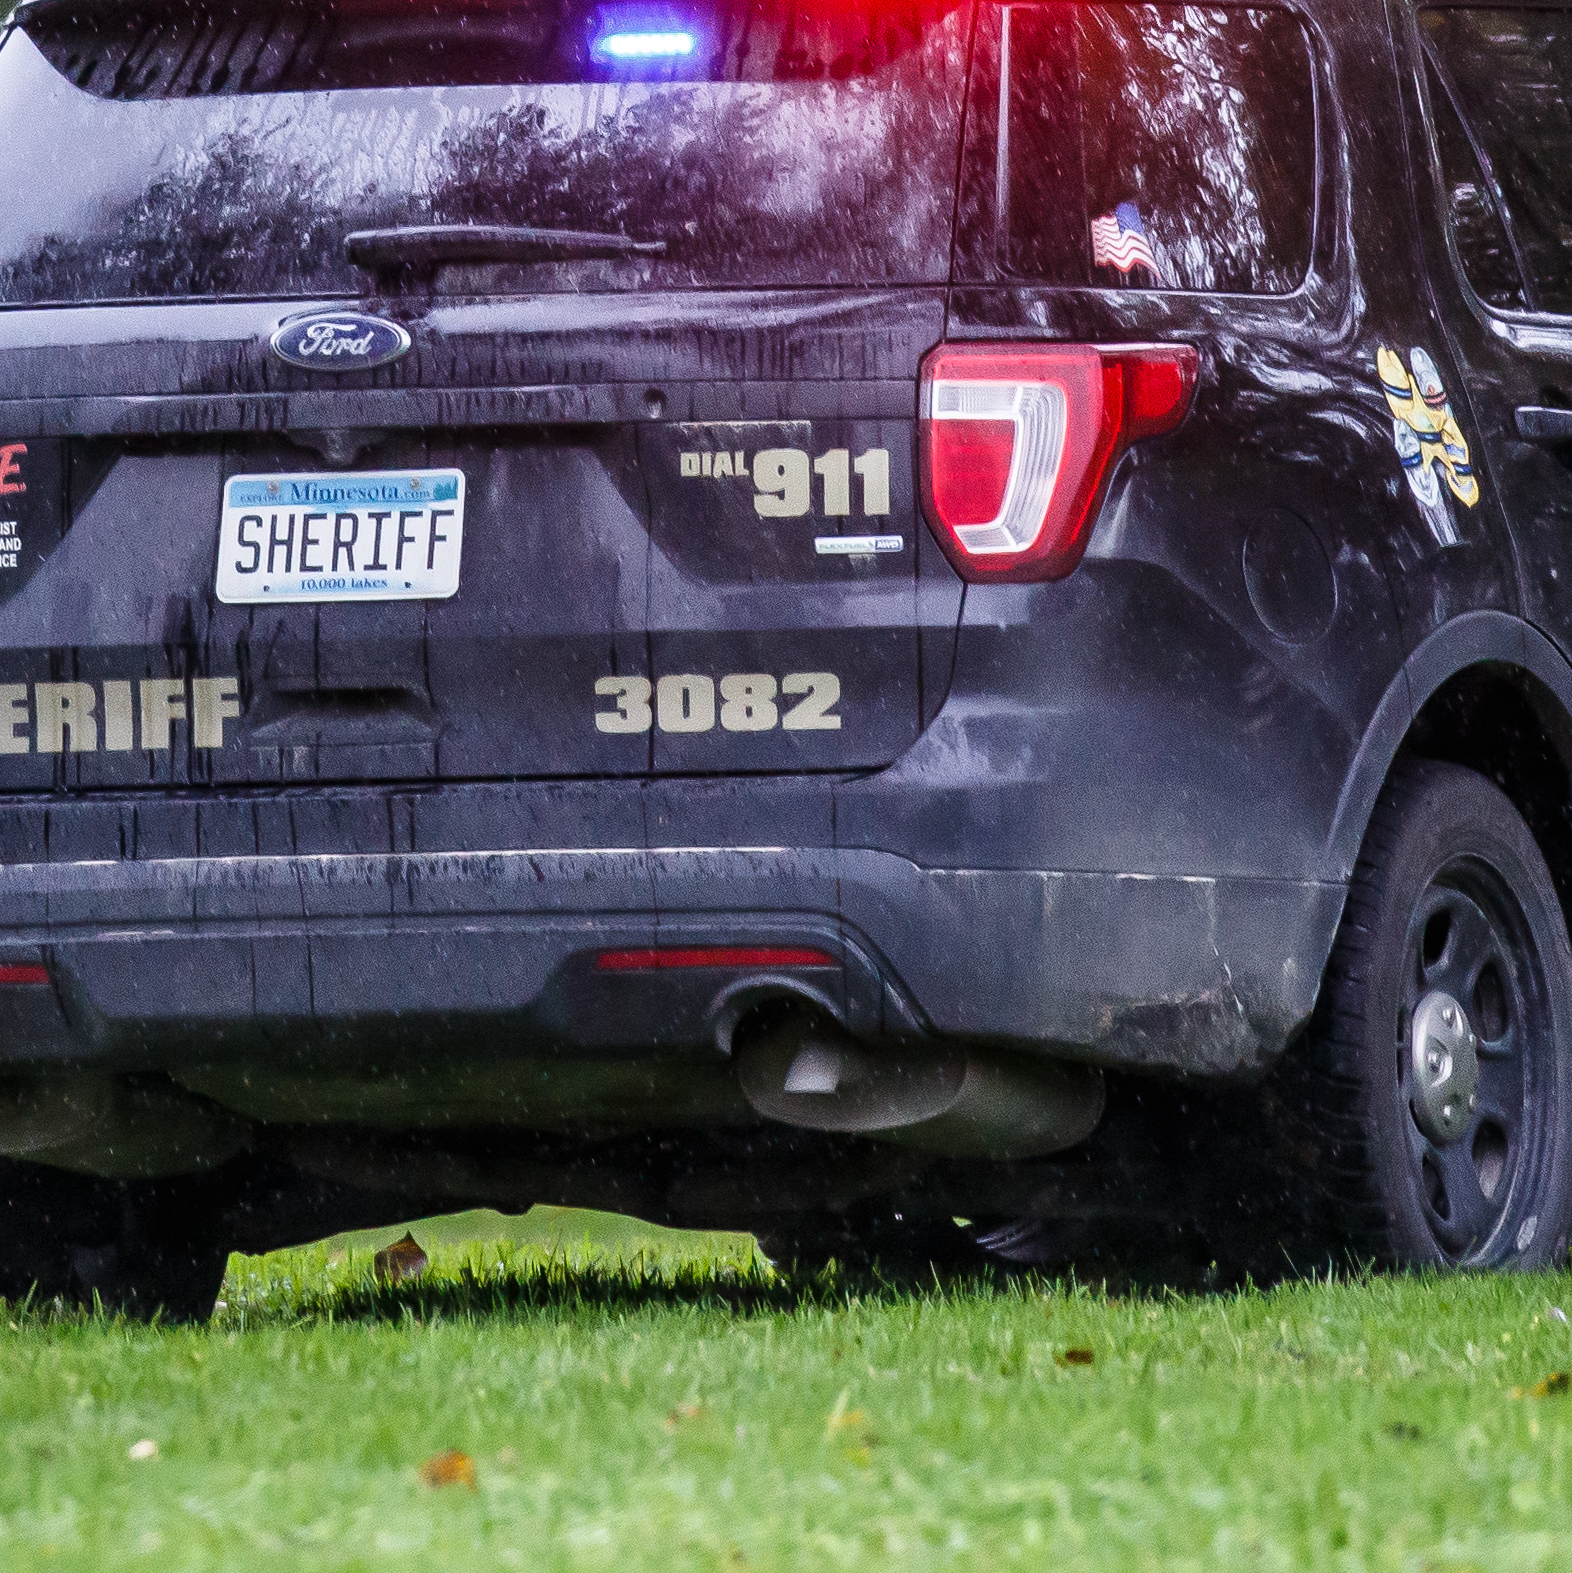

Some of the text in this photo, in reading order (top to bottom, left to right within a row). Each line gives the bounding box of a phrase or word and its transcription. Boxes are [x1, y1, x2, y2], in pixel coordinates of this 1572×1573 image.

[298, 322, 375, 356] Ford
[680, 448, 891, 518] DIAL 911
[234, 509, 455, 574] SHERIFF
[876, 539, 900, 549] AWD
[351, 577, 389, 589] lakes
[594, 672, 842, 734] 3082
